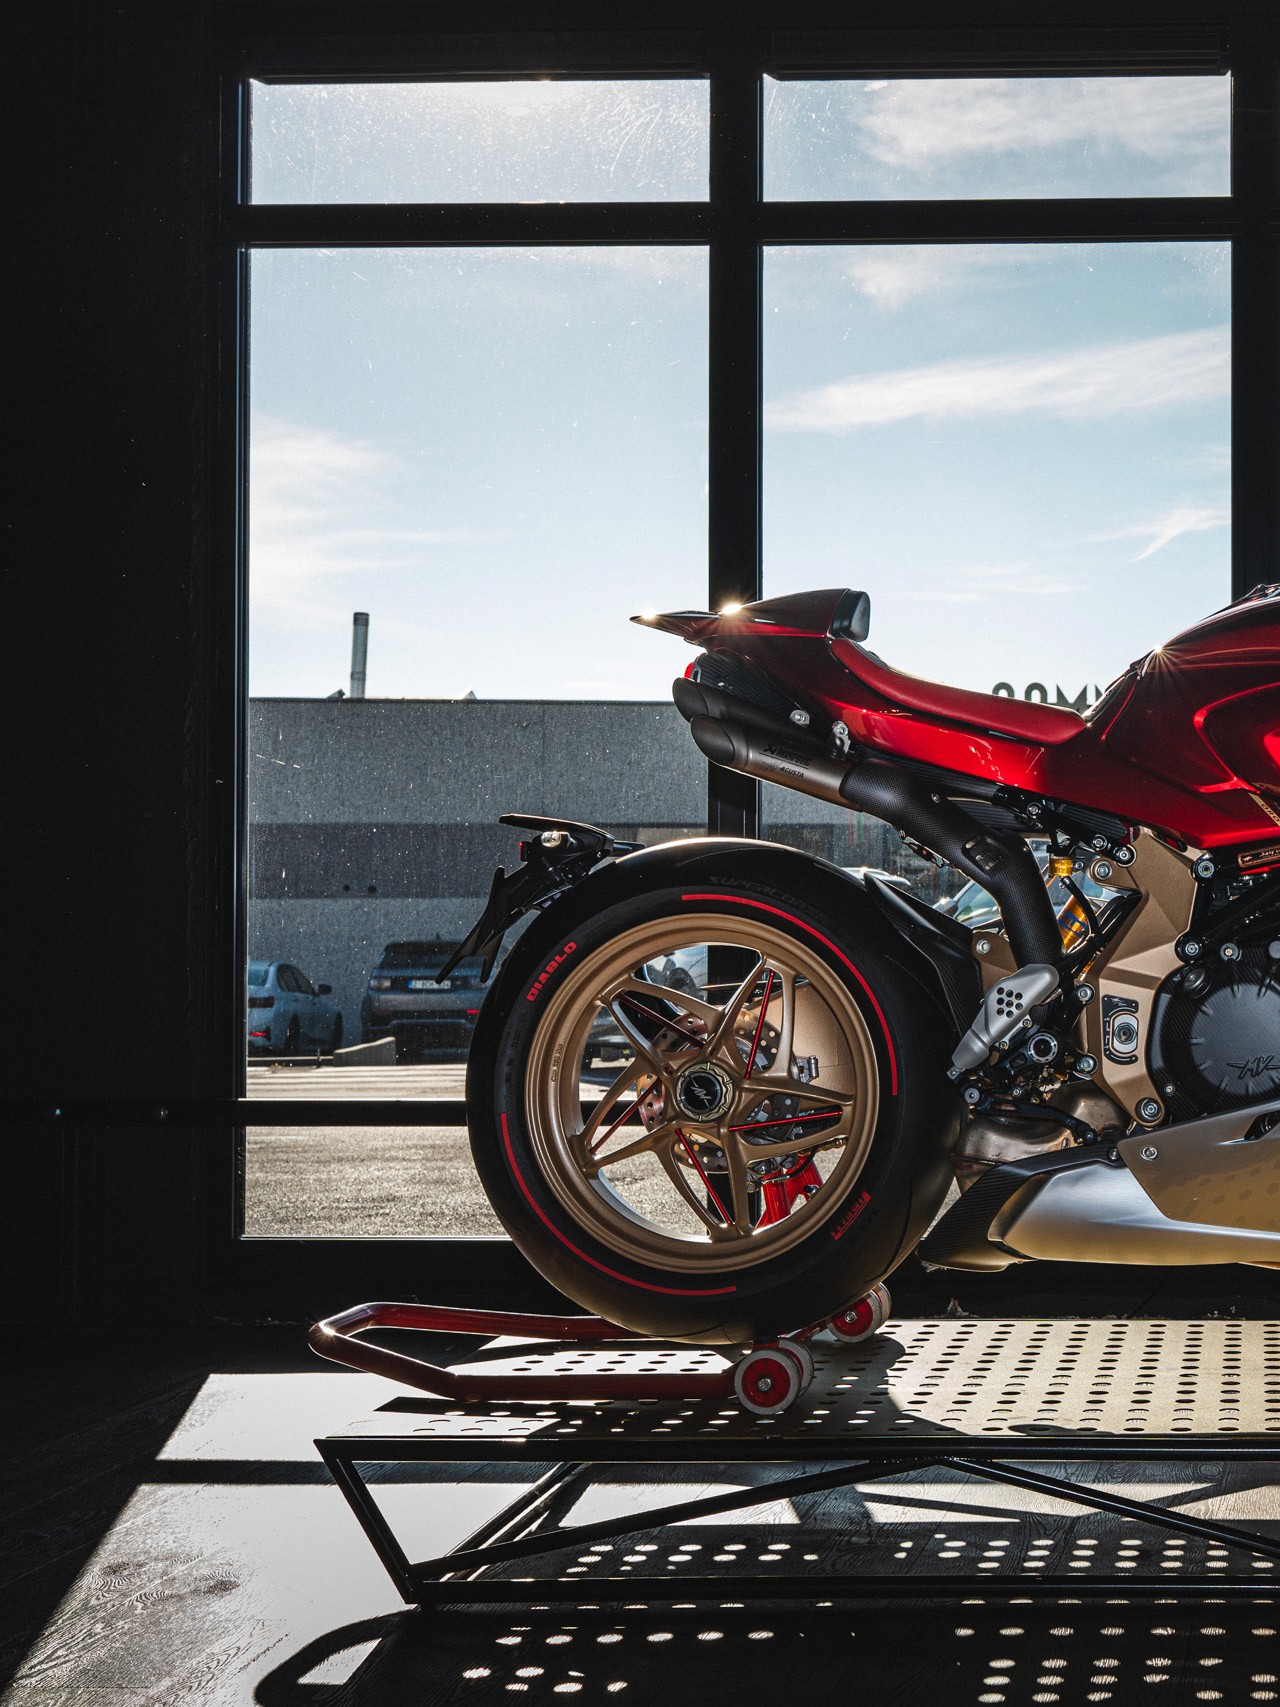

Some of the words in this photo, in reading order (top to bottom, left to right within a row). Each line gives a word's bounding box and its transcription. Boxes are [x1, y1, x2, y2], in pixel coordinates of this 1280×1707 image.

[780, 767, 804, 778] AGUSTA
[1261, 803, 1280, 822] ORO
[526, 941, 577, 1001] DIABLO
[1238, 1055, 1274, 1079] MV
